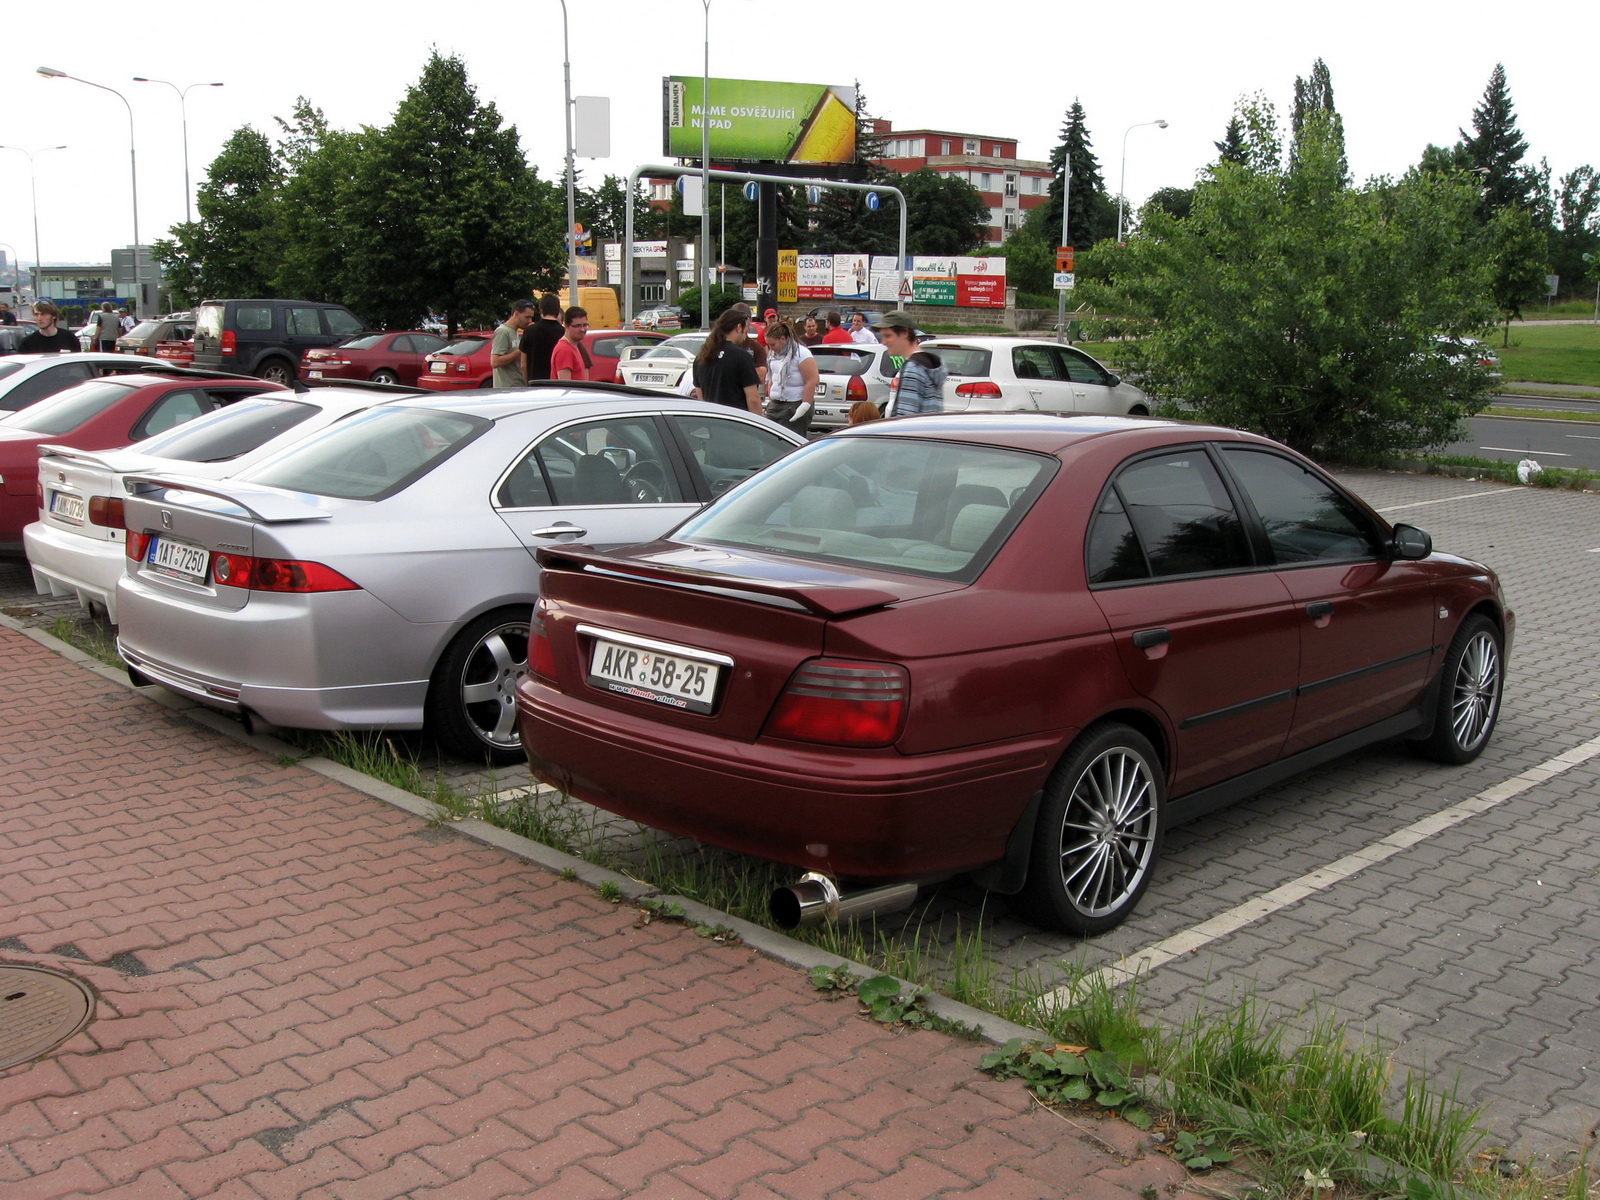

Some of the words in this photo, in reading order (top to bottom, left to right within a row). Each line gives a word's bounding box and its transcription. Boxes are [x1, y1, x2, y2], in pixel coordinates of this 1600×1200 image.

[731, 106, 796, 119] OSVĚŽUJÍCÍ
[799, 259, 832, 269] CESARO
[158, 542, 176, 565] 1AT
[179, 547, 205, 573] 7250
[600, 646, 638, 681] AKR
[650, 656, 708, 696] 58-25
